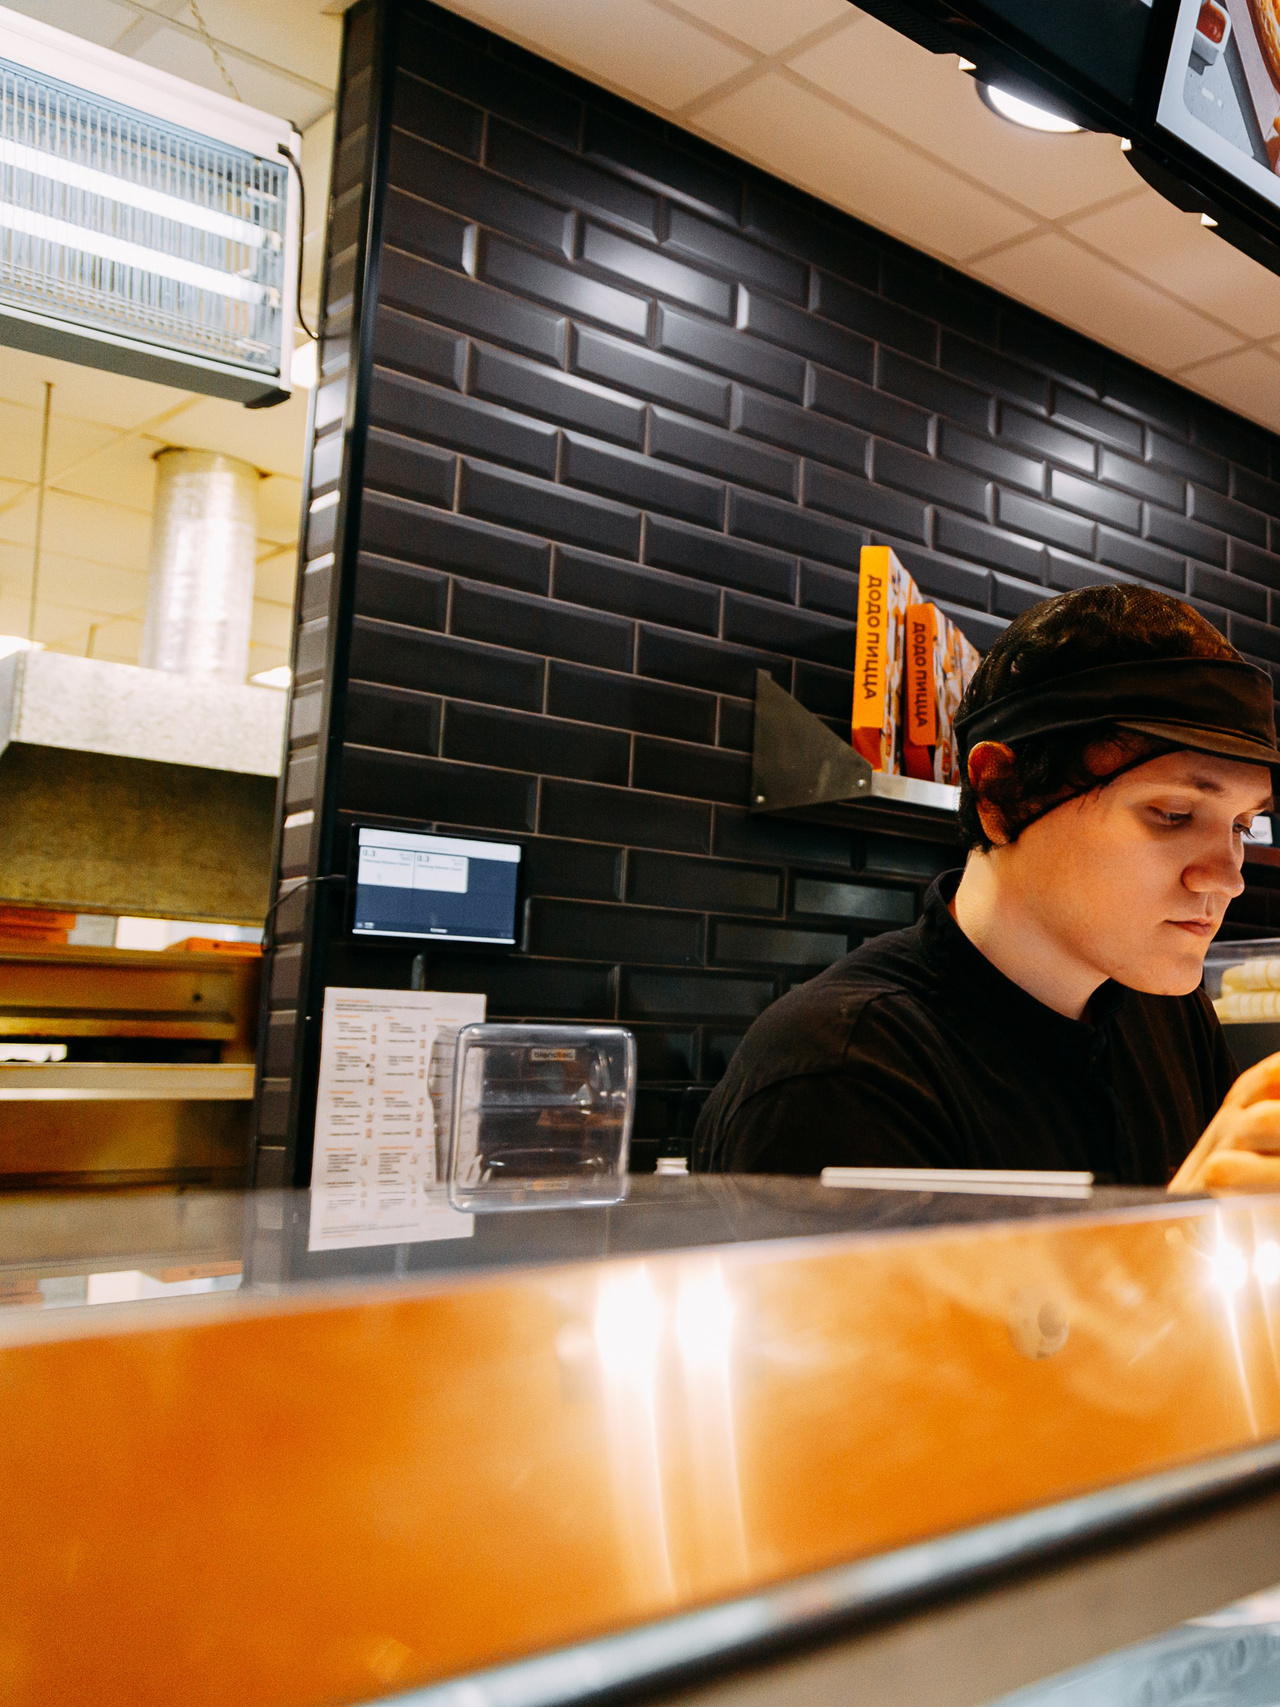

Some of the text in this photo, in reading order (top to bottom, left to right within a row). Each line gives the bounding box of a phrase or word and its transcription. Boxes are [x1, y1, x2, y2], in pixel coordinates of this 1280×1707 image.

[864, 574, 882, 700] ДОДО ПИЦЦА
[912, 621, 928, 728] ДОДО ПИЦЦА
